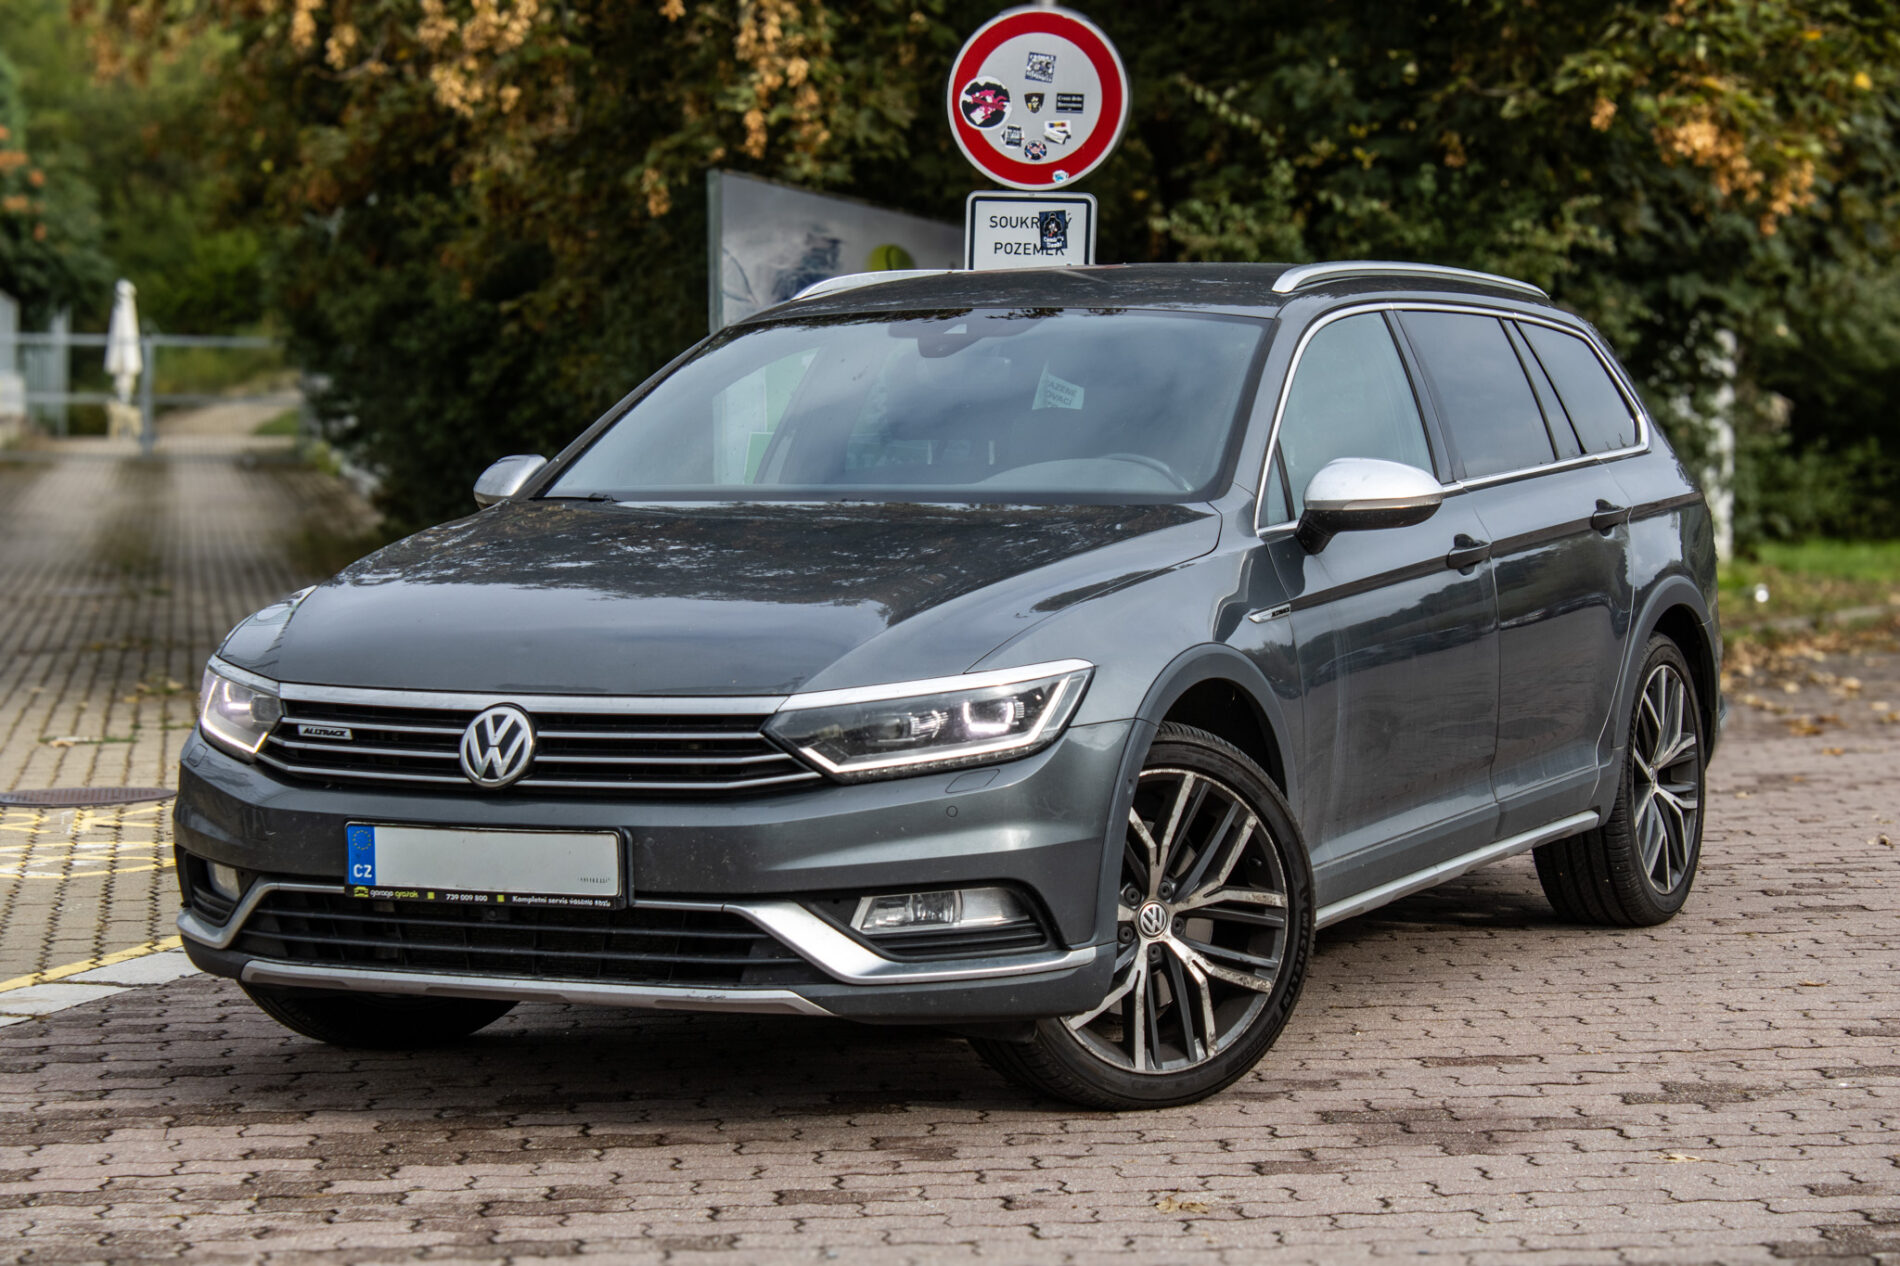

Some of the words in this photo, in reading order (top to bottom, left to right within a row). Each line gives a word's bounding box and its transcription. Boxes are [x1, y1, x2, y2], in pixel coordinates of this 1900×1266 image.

[989, 211, 1072, 229] SOUKRÝ
[303, 727, 346, 738] ALLTRACK
[353, 863, 372, 878] CZ
[1281, 911, 1311, 1008] MICHELIN
